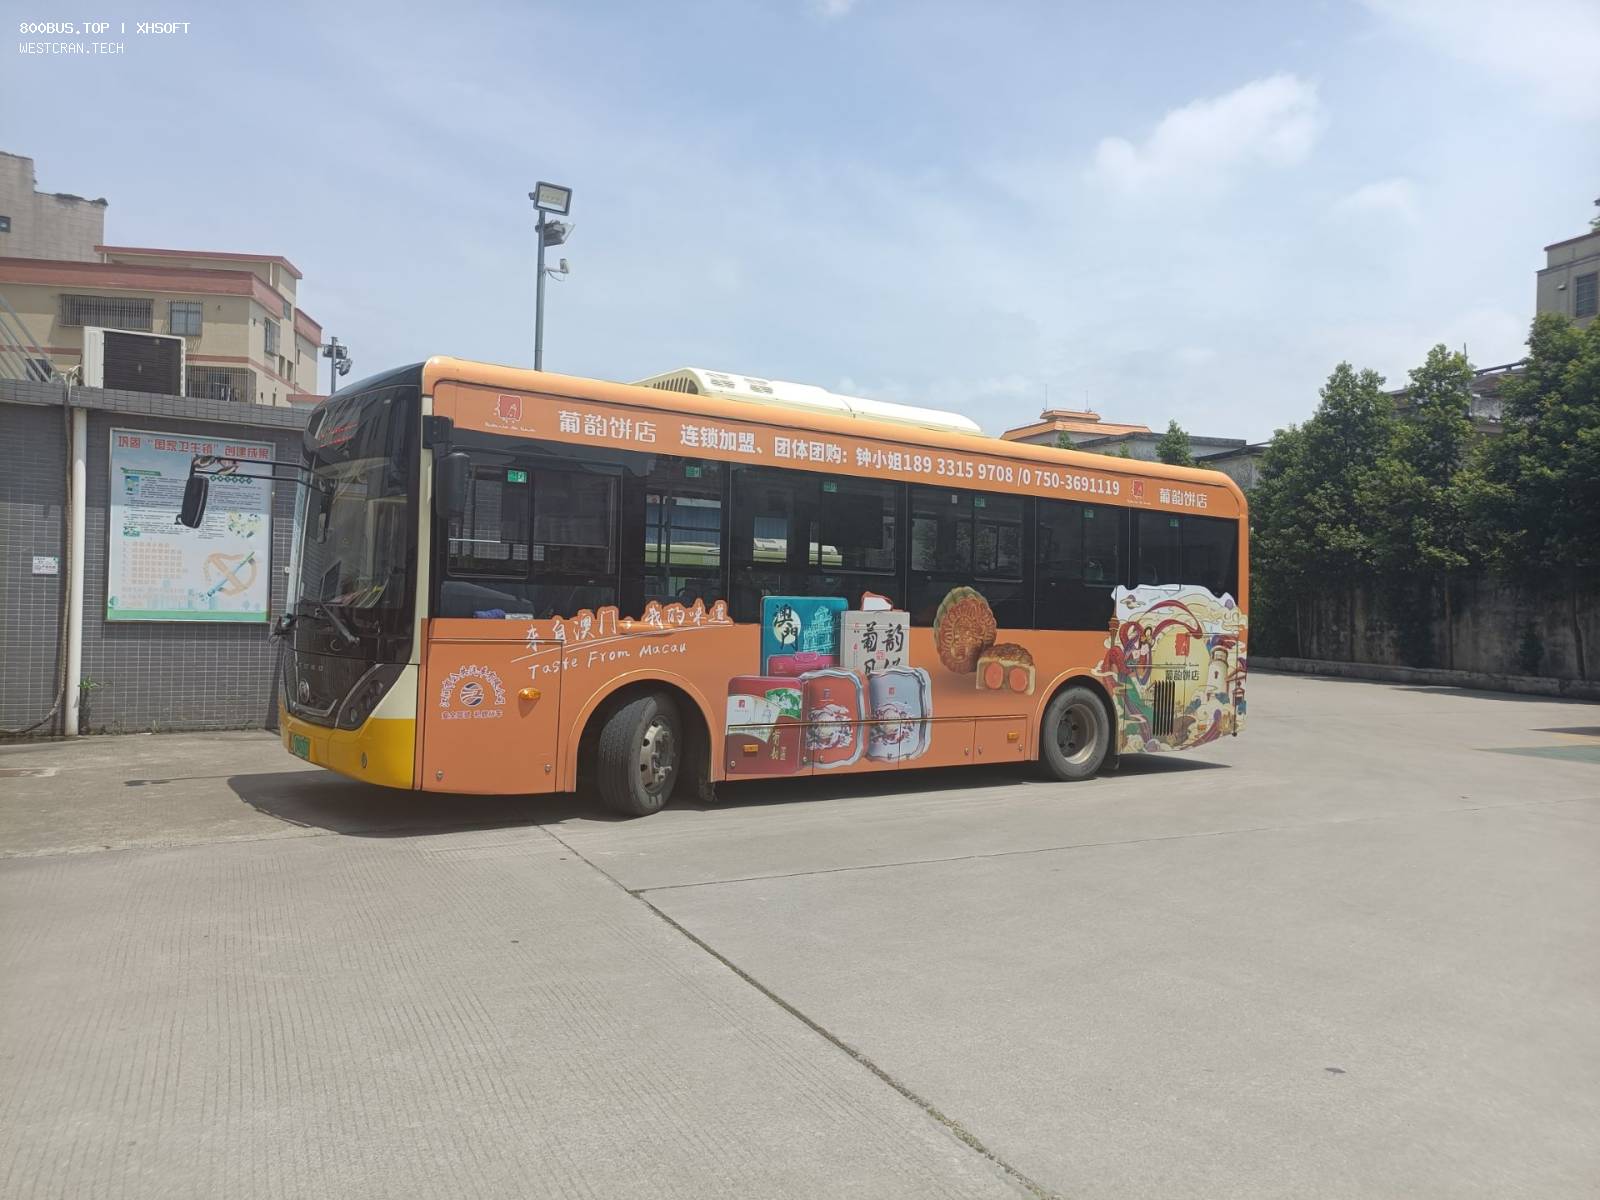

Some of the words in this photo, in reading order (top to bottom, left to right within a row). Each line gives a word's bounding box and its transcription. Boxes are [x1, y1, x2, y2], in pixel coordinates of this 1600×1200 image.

[936, 456, 974, 479] 3315
[978, 461, 1013, 482] 9708
[1035, 471, 1120, 497] 750-3691119
[528, 657, 578, 679] Taste
[588, 650, 630, 668] From
[639, 643, 687, 657] Macau
